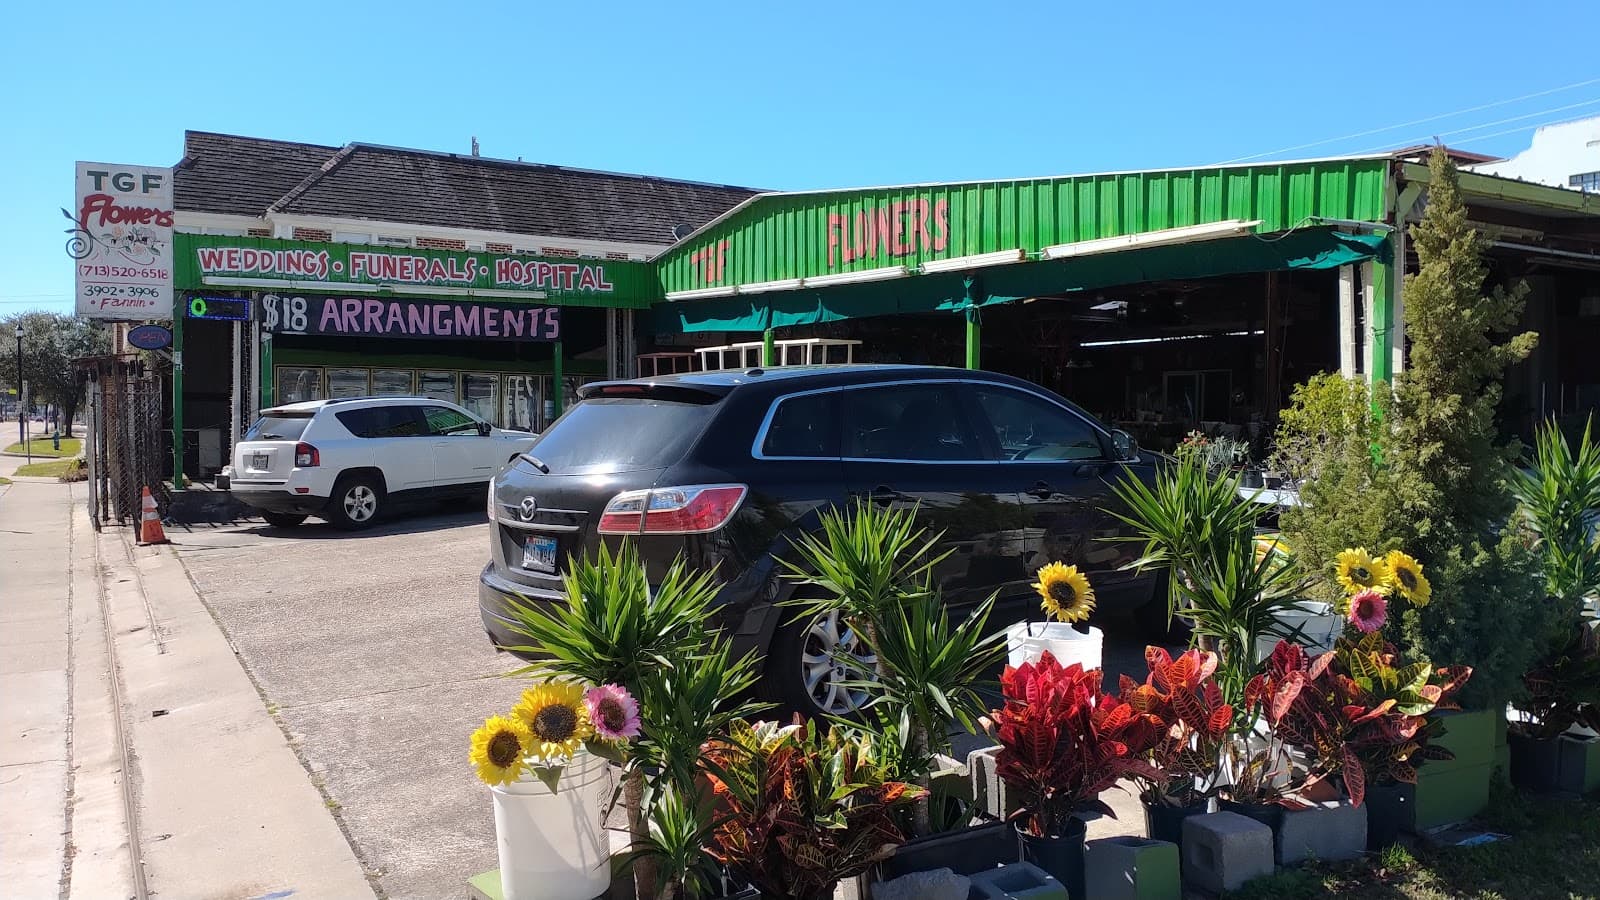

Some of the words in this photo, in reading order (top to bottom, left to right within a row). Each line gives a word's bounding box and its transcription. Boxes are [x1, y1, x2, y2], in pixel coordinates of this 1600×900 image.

[87, 170, 163, 193] TGF
[80, 193, 174, 230] Flowers
[827, 197, 948, 268] FLOWERS
[198, 248, 329, 279] WEDDINGS
[350, 253, 476, 282] FUNERALS
[495, 258, 613, 292] HOSPITAL
[83, 285, 118, 296] 3902
[127, 286, 159, 298] 3906
[100, 297, 146, 310] Fannin
[263, 295, 307, 332] $18
[319, 299, 559, 338] ARRANGMENTS
